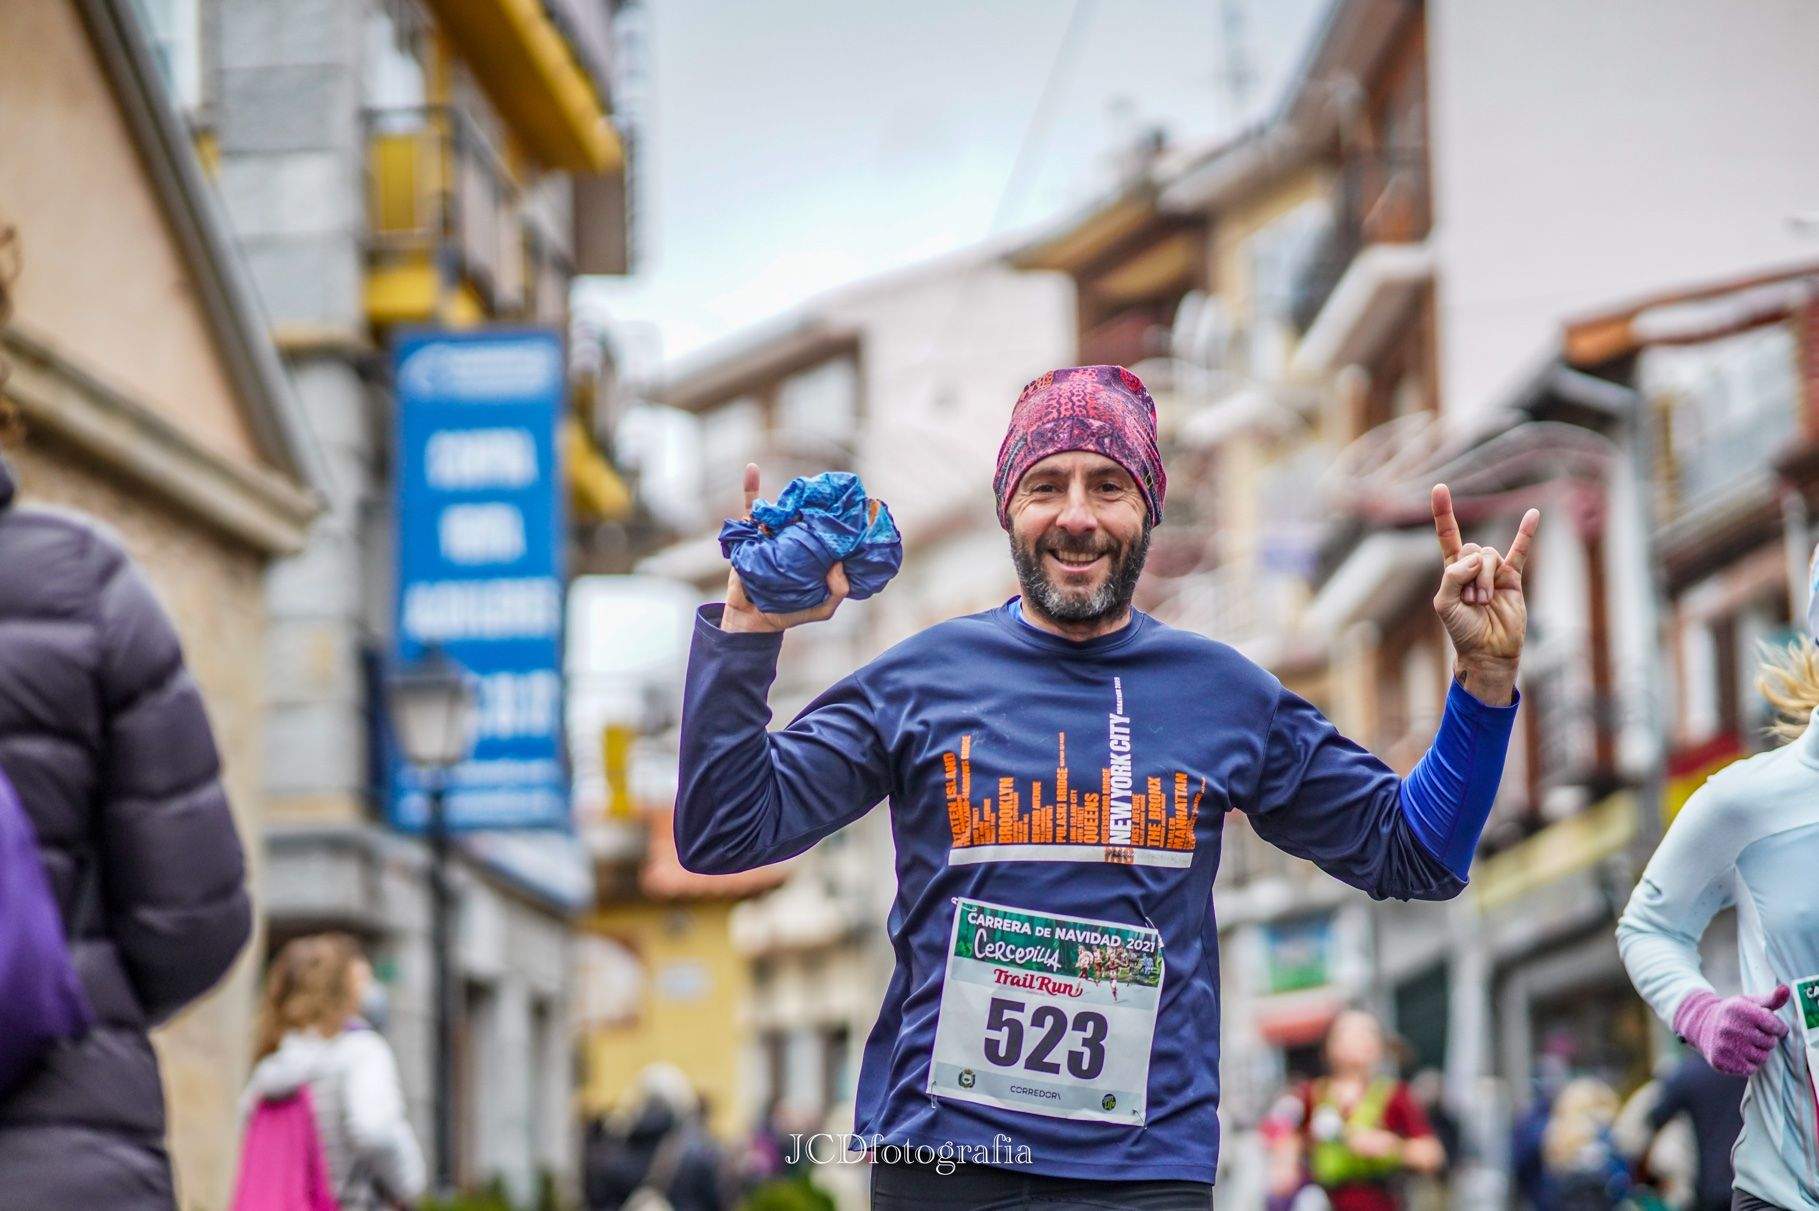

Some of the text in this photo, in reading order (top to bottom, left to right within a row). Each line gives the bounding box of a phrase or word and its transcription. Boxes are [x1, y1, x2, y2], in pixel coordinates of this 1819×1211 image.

[1109, 713, 1132, 752] CITY
[1057, 768, 1068, 801] BRIDGE
[1110, 752, 1132, 801] YORK
[999, 777, 1014, 843] BROOKLYN
[1056, 803, 1067, 843] PULASKI
[1083, 792, 1099, 844] QUEENS
[1110, 799, 1132, 845] NEW
[1147, 777, 1161, 847] THE BRONX
[1173, 772, 1188, 849] MANHATTAN
[968, 912, 1156, 953] CARRERA DE NAVIDAD 2021
[994, 968, 1083, 998] Trail Run
[984, 997, 1108, 1080] 523
